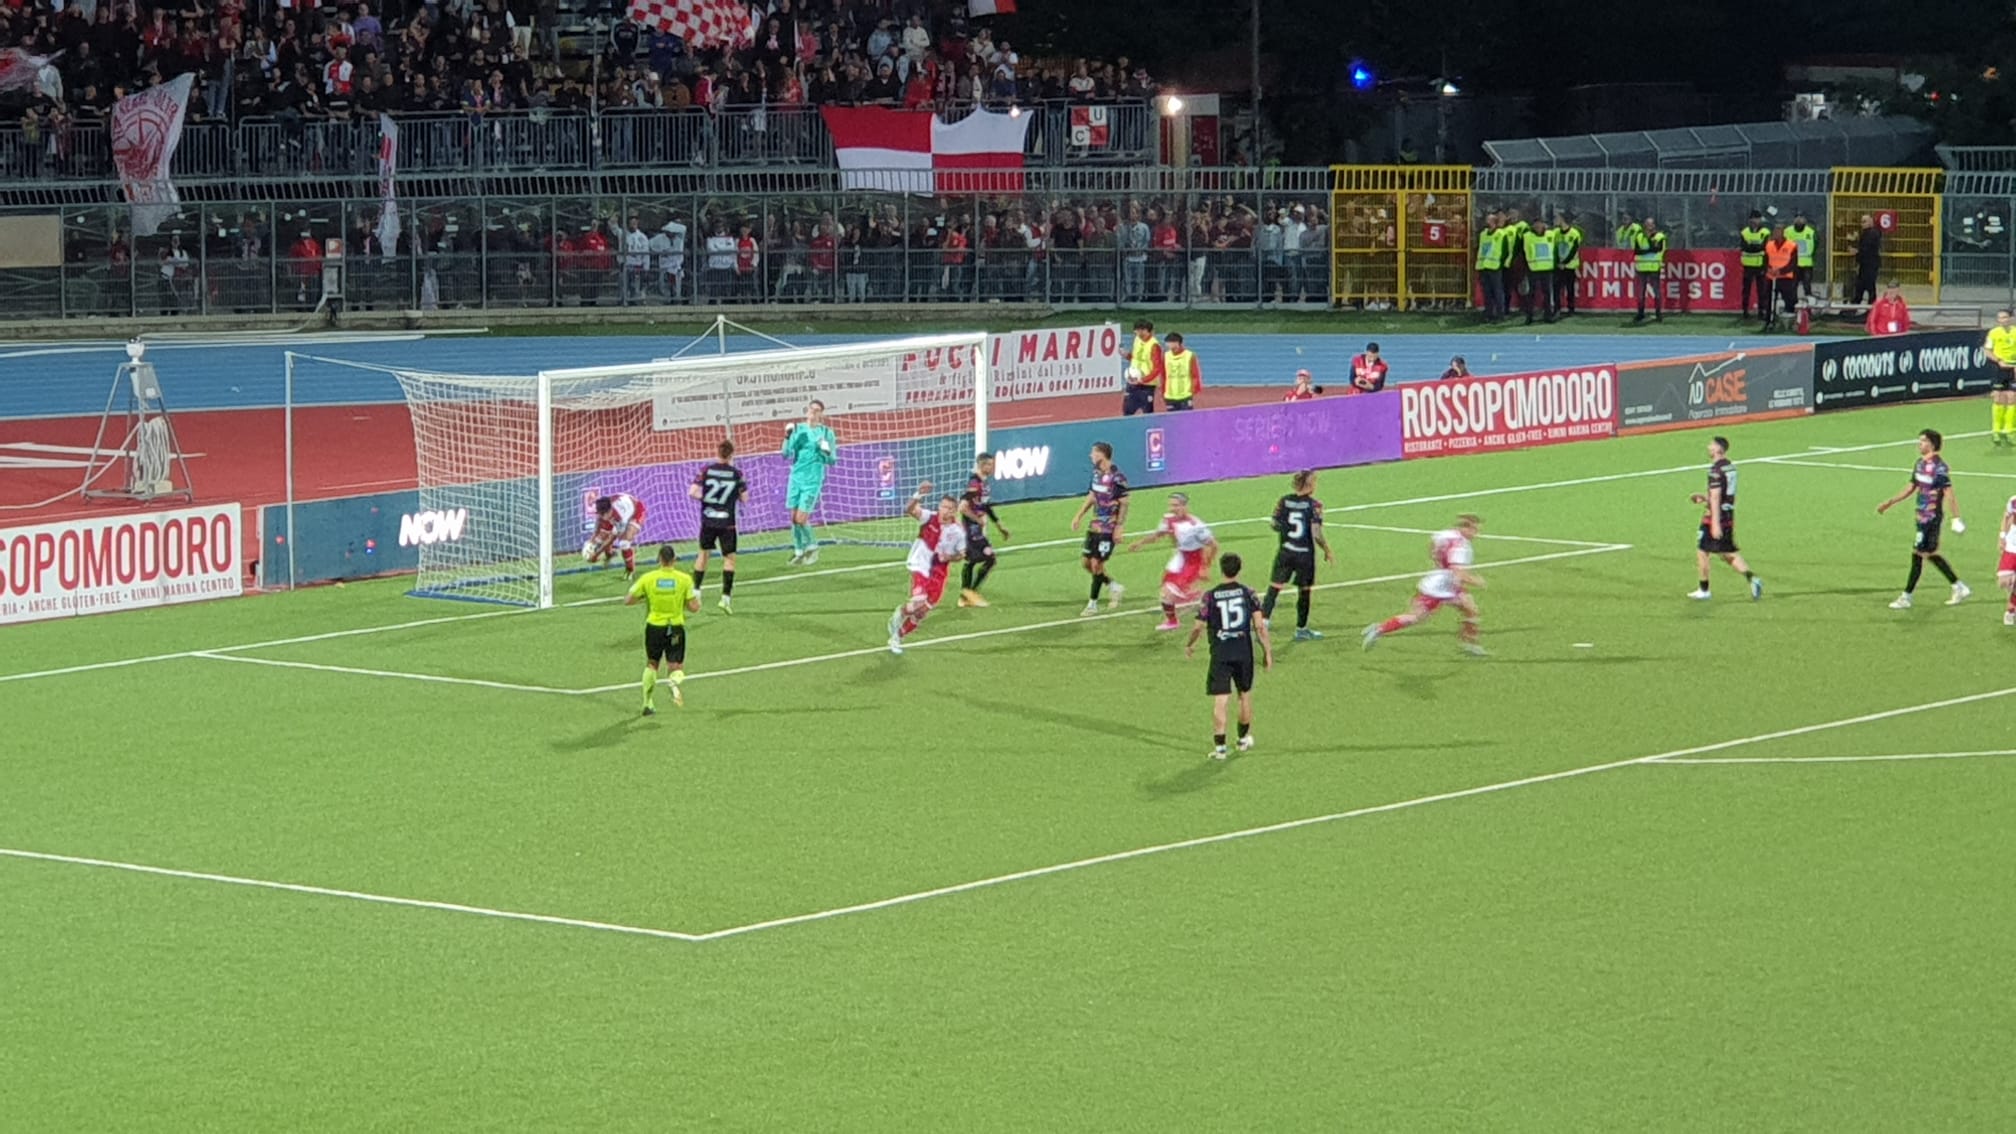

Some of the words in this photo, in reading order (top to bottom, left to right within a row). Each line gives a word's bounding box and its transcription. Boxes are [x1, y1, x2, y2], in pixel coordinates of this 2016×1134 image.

[1093, 107, 1104, 121] U
[1075, 130, 1085, 143] C
[1430, 226, 1440, 241] 5
[1880, 213, 1891, 229] 6
[1018, 328, 1116, 364] MARIO
[994, 367, 1032, 382] Rimini
[1037, 365, 1054, 378] dal
[1059, 363, 1083, 376] 1938
[1705, 369, 1748, 404] CASE
[905, 388, 975, 404] FERRAMENT
[994, 381, 1044, 398] EDILIZIA
[1049, 379, 1073, 392] 0541
[1401, 369, 1613, 439] ROSSOPOMODORO
[994, 445, 1050, 481] NOW
[703, 478, 736, 505] 27
[399, 507, 466, 546] NOW
[1287, 511, 1304, 539] 5
[28, 596, 59, 613] ANCHE
[131, 585, 160, 601] RIMINI
[163, 580, 197, 597] MARINA
[200, 576, 235, 593] CENTRO
[1216, 597, 1244, 630] 15
